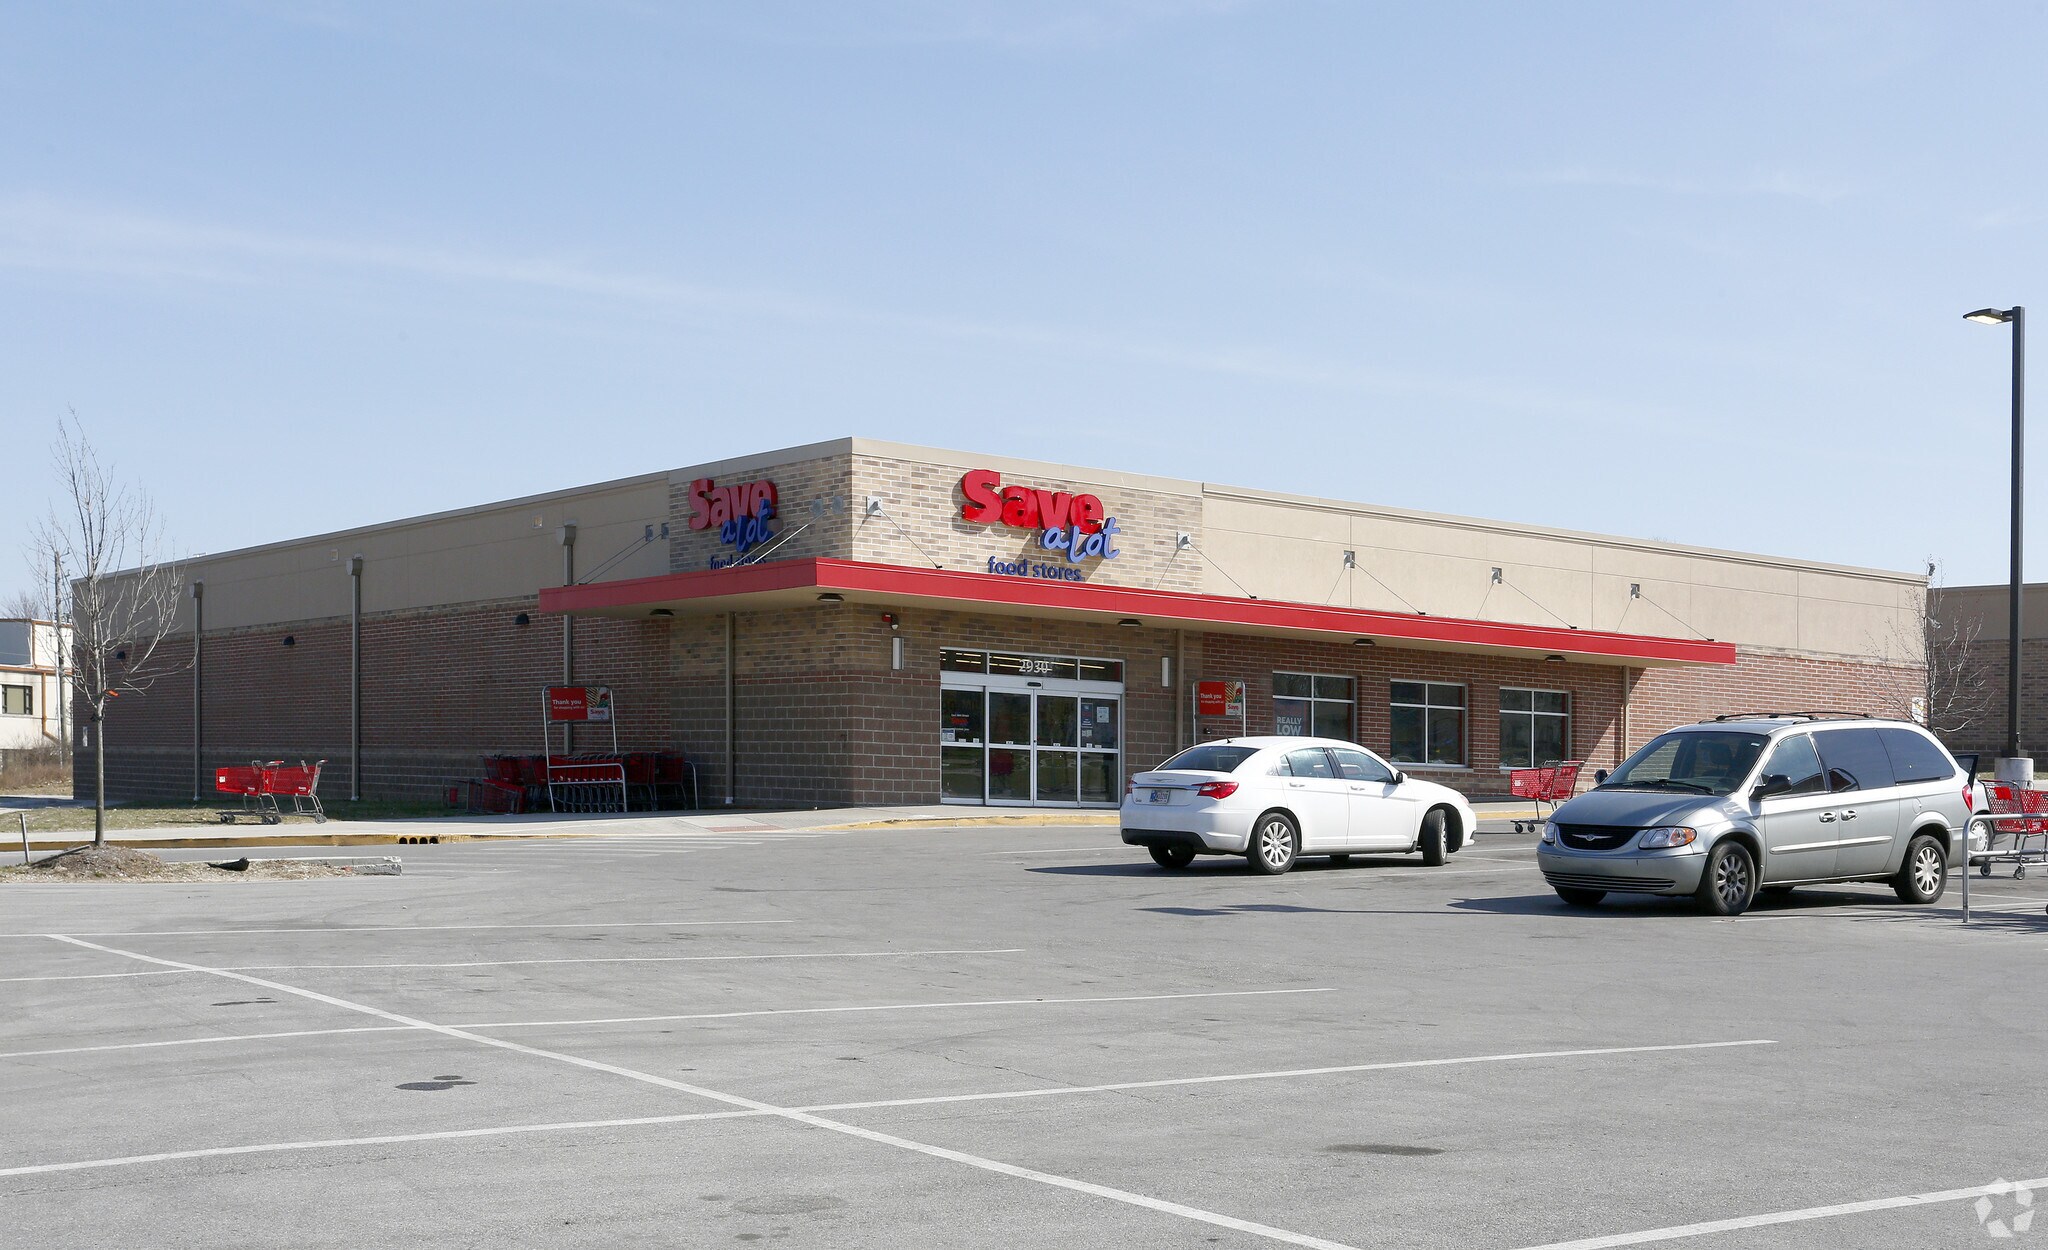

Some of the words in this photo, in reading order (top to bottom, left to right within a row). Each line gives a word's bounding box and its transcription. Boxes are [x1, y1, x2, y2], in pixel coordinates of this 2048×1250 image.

[688, 478, 778, 530] Save
[962, 469, 1104, 534] Save
[987, 556, 1028, 576] food
[1033, 563, 1083, 581] stores
[1019, 660, 1048, 674] 2930
[1277, 716, 1302, 725] REALLY
[1277, 724, 1301, 736] LOW
